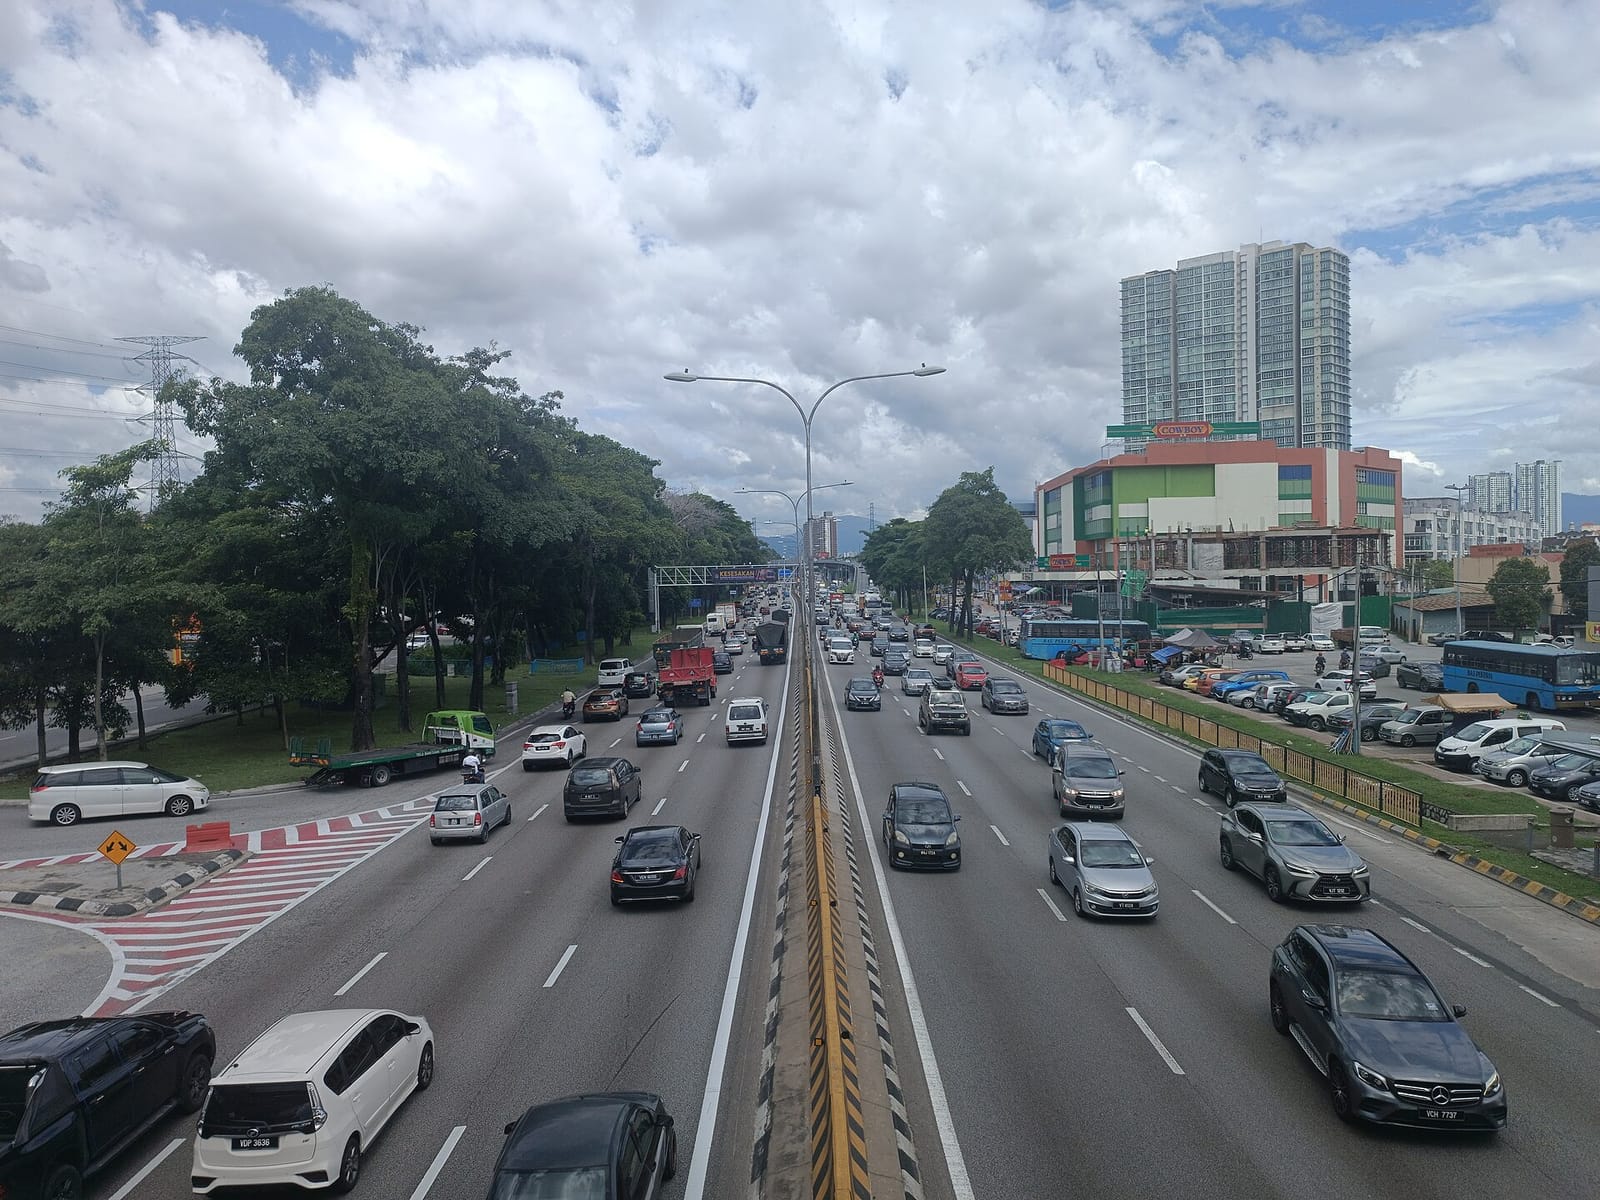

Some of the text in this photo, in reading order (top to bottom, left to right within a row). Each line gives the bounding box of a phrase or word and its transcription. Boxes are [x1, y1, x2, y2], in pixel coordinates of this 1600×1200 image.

[1162, 426, 1203, 434] COWBOY
[1426, 1110, 1457, 1119] VCH 7737
[240, 1138, 270, 1147] VDP 3636
